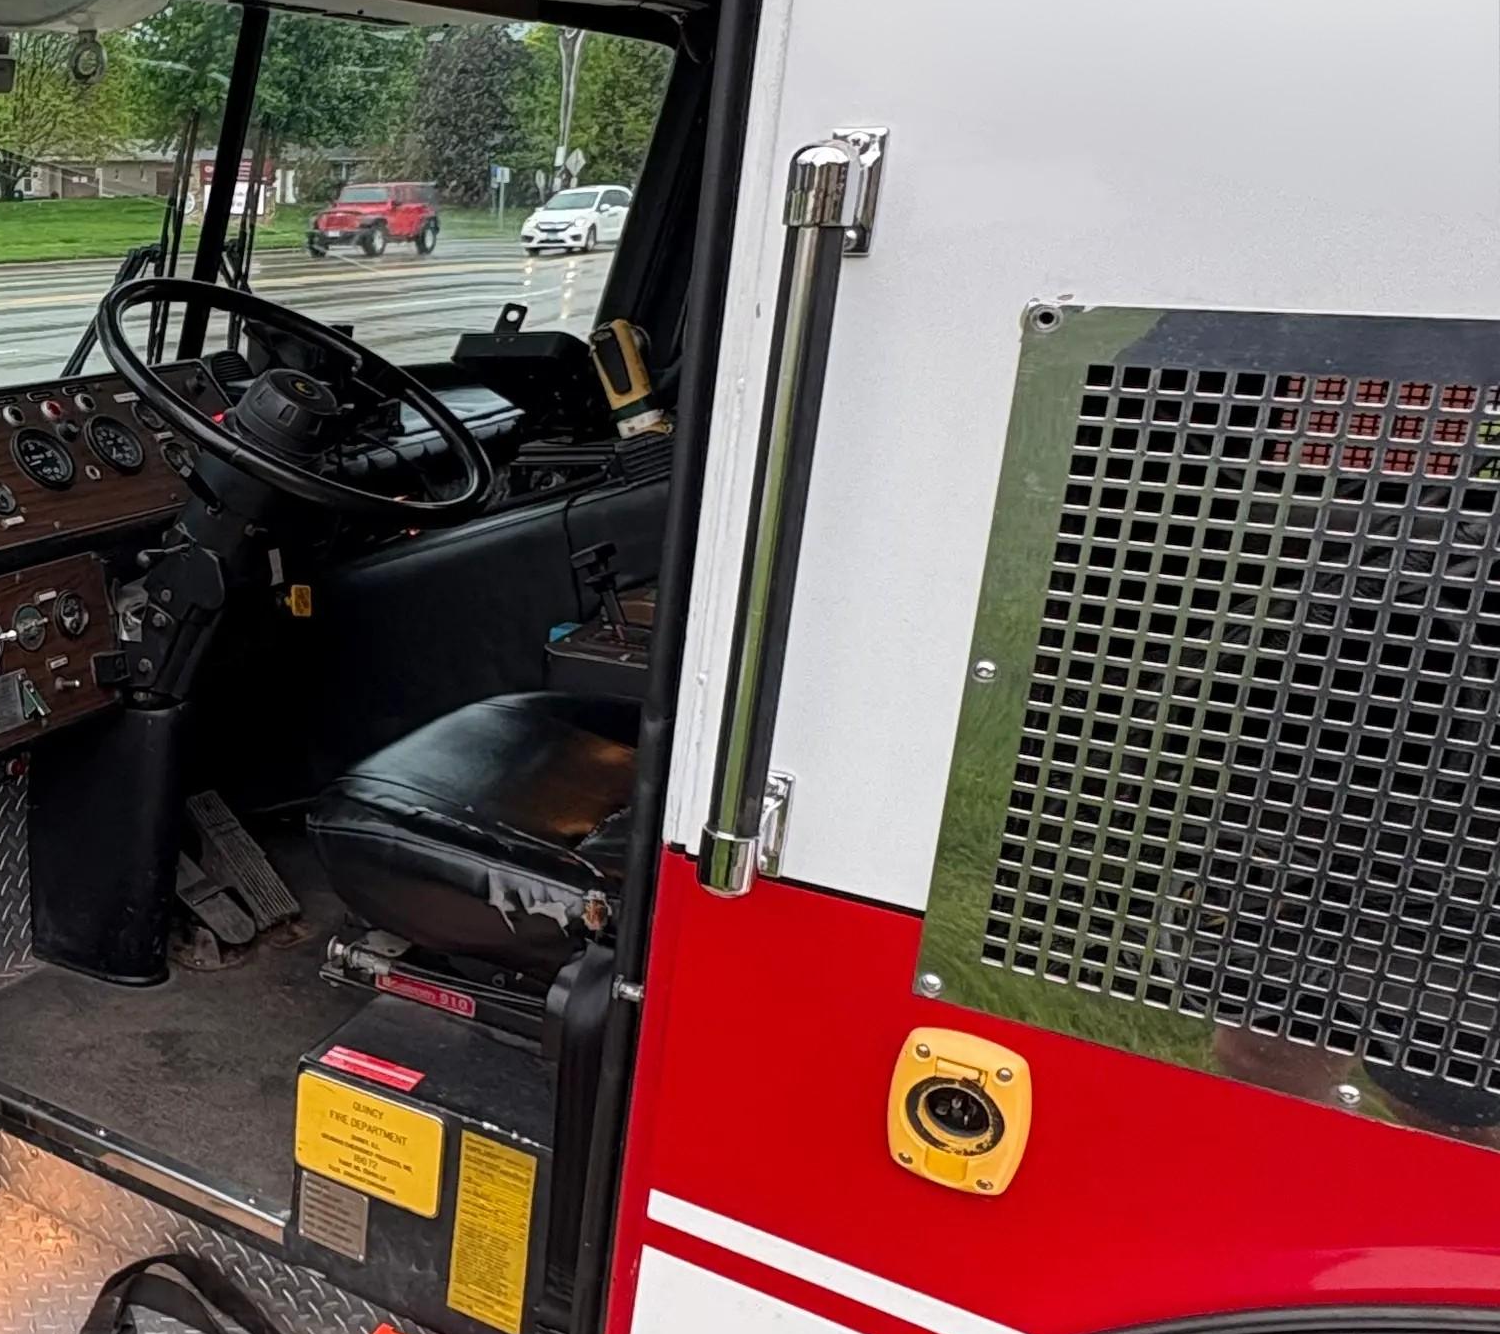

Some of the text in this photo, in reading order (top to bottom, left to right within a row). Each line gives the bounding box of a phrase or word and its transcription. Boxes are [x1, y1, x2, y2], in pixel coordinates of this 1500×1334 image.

[352, 1101, 384, 1120] QUINCY
[329, 1110, 349, 1125] FIRE
[350, 1118, 408, 1146] DEPARTMENT
